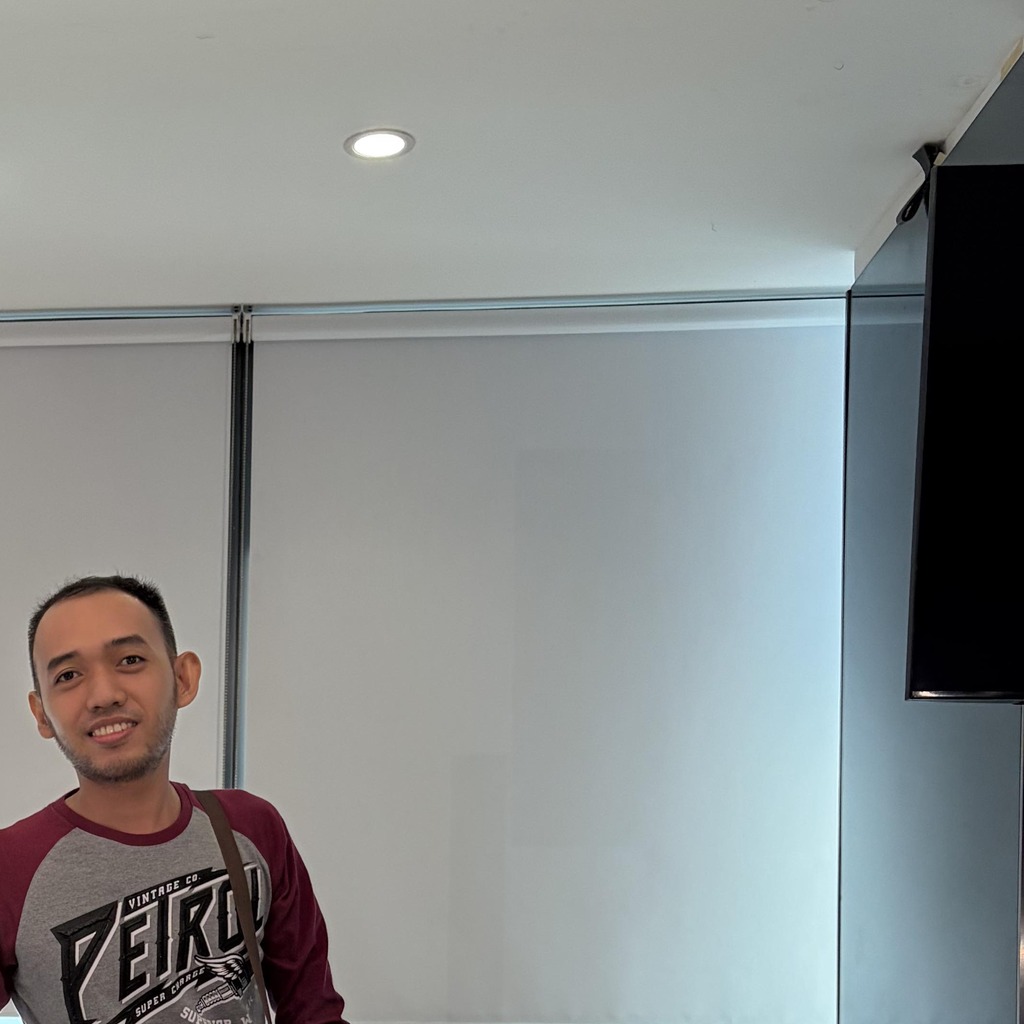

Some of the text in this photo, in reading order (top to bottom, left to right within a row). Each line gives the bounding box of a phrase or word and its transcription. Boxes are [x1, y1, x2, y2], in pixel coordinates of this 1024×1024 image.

[128, 873, 201, 909] VINTAGE CO.
[135, 966, 206, 1018] SUPER CHARGE
